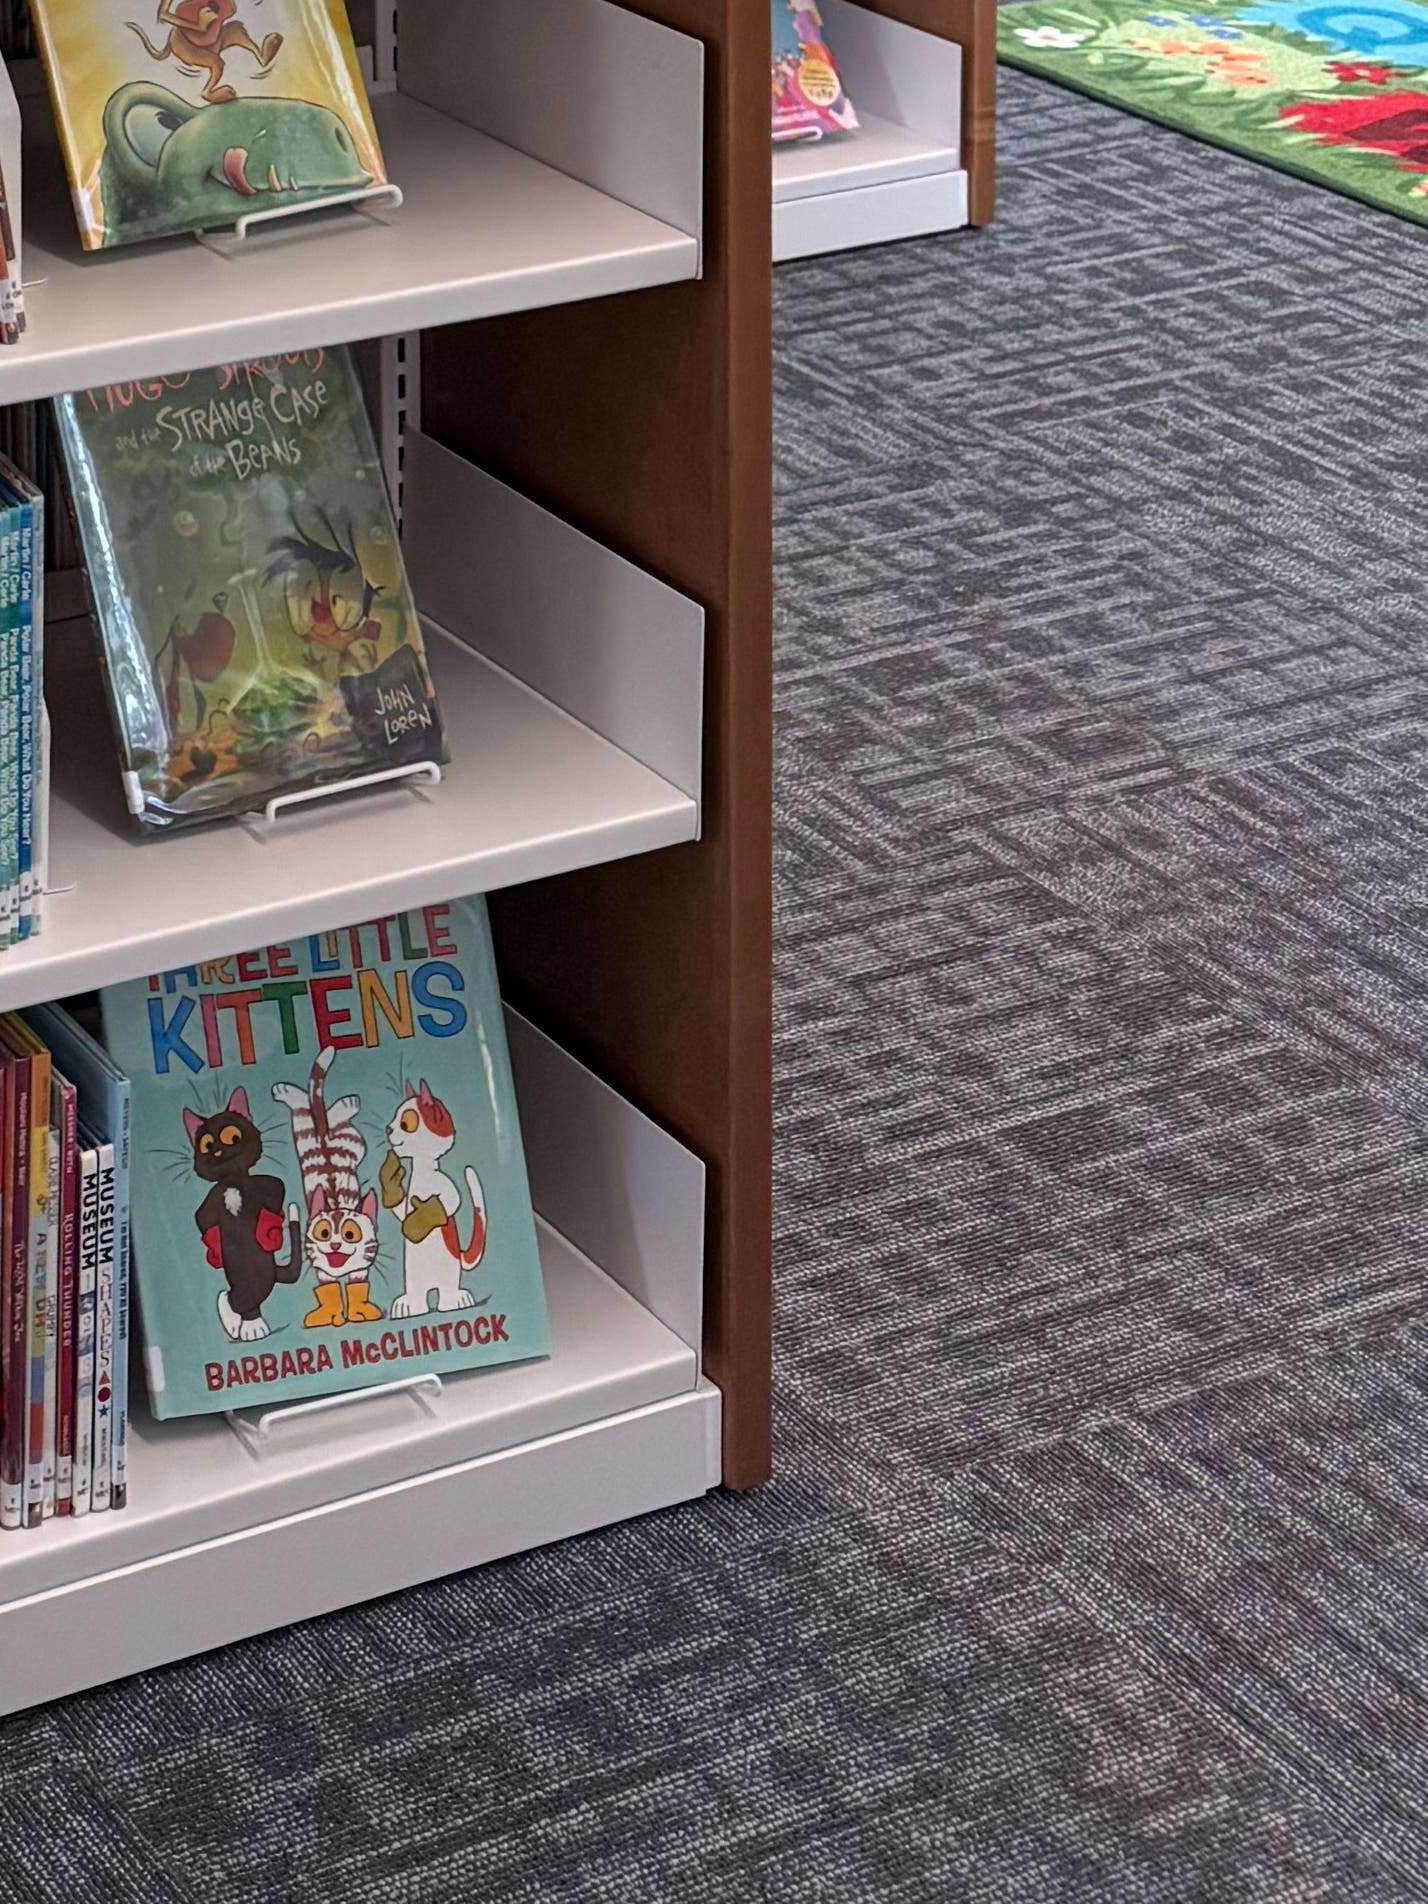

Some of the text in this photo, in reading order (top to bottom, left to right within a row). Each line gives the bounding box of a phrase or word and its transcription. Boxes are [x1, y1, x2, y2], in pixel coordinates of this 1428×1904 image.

[374, 685, 413, 717] JOHN
[308, 904, 459, 973] LITTLE
[147, 960, 468, 1074] KITTENS
[82, 1173, 98, 1272] MUSEUM
[98, 1167, 116, 1367] MUSEUM SHAPES
[204, 1313, 510, 1392] BARBARA McCLINTOCK
